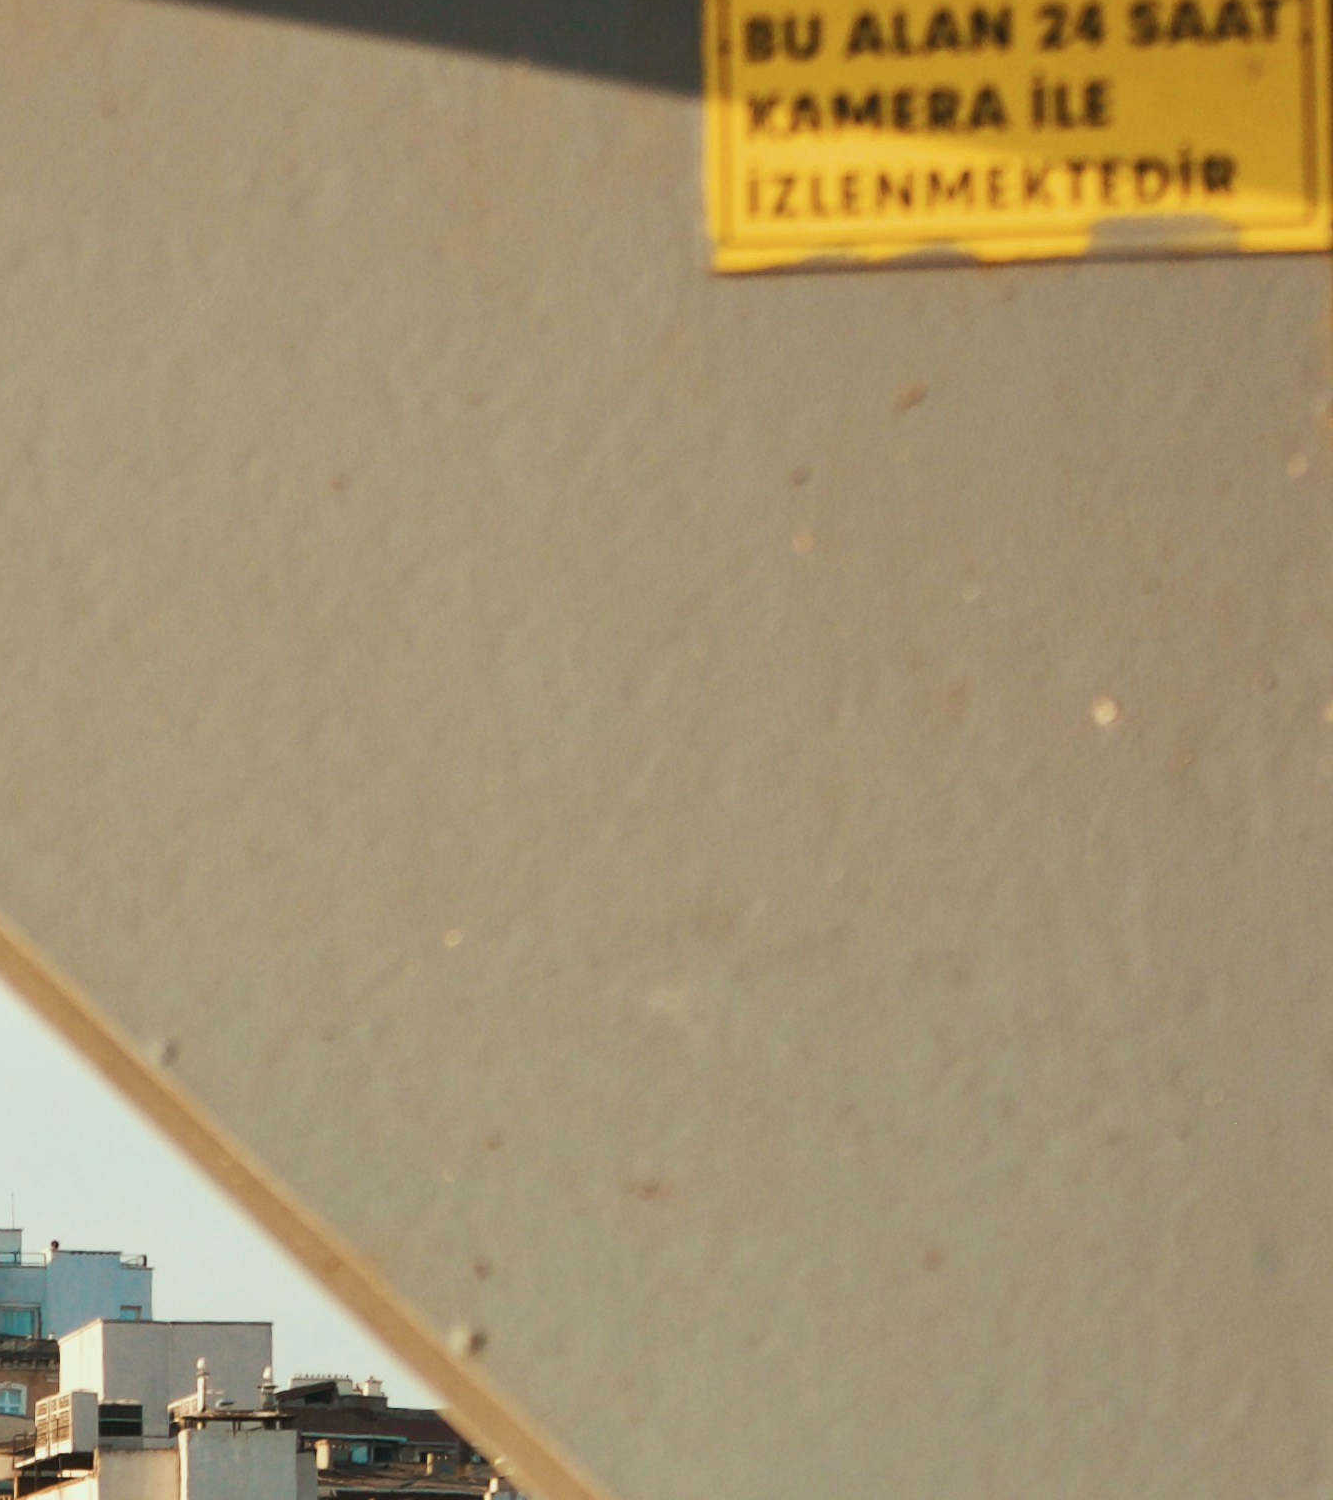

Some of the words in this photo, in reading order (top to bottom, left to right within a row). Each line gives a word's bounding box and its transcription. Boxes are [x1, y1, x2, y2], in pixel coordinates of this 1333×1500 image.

[743, 14, 824, 64] BU
[846, 6, 1012, 58] ALAN
[1036, 1, 1105, 52] 24
[747, 84, 1007, 139] KAMERA
[1031, 69, 1113, 130] İLE
[747, 142, 1237, 220] İZLENMEKTEDİR
